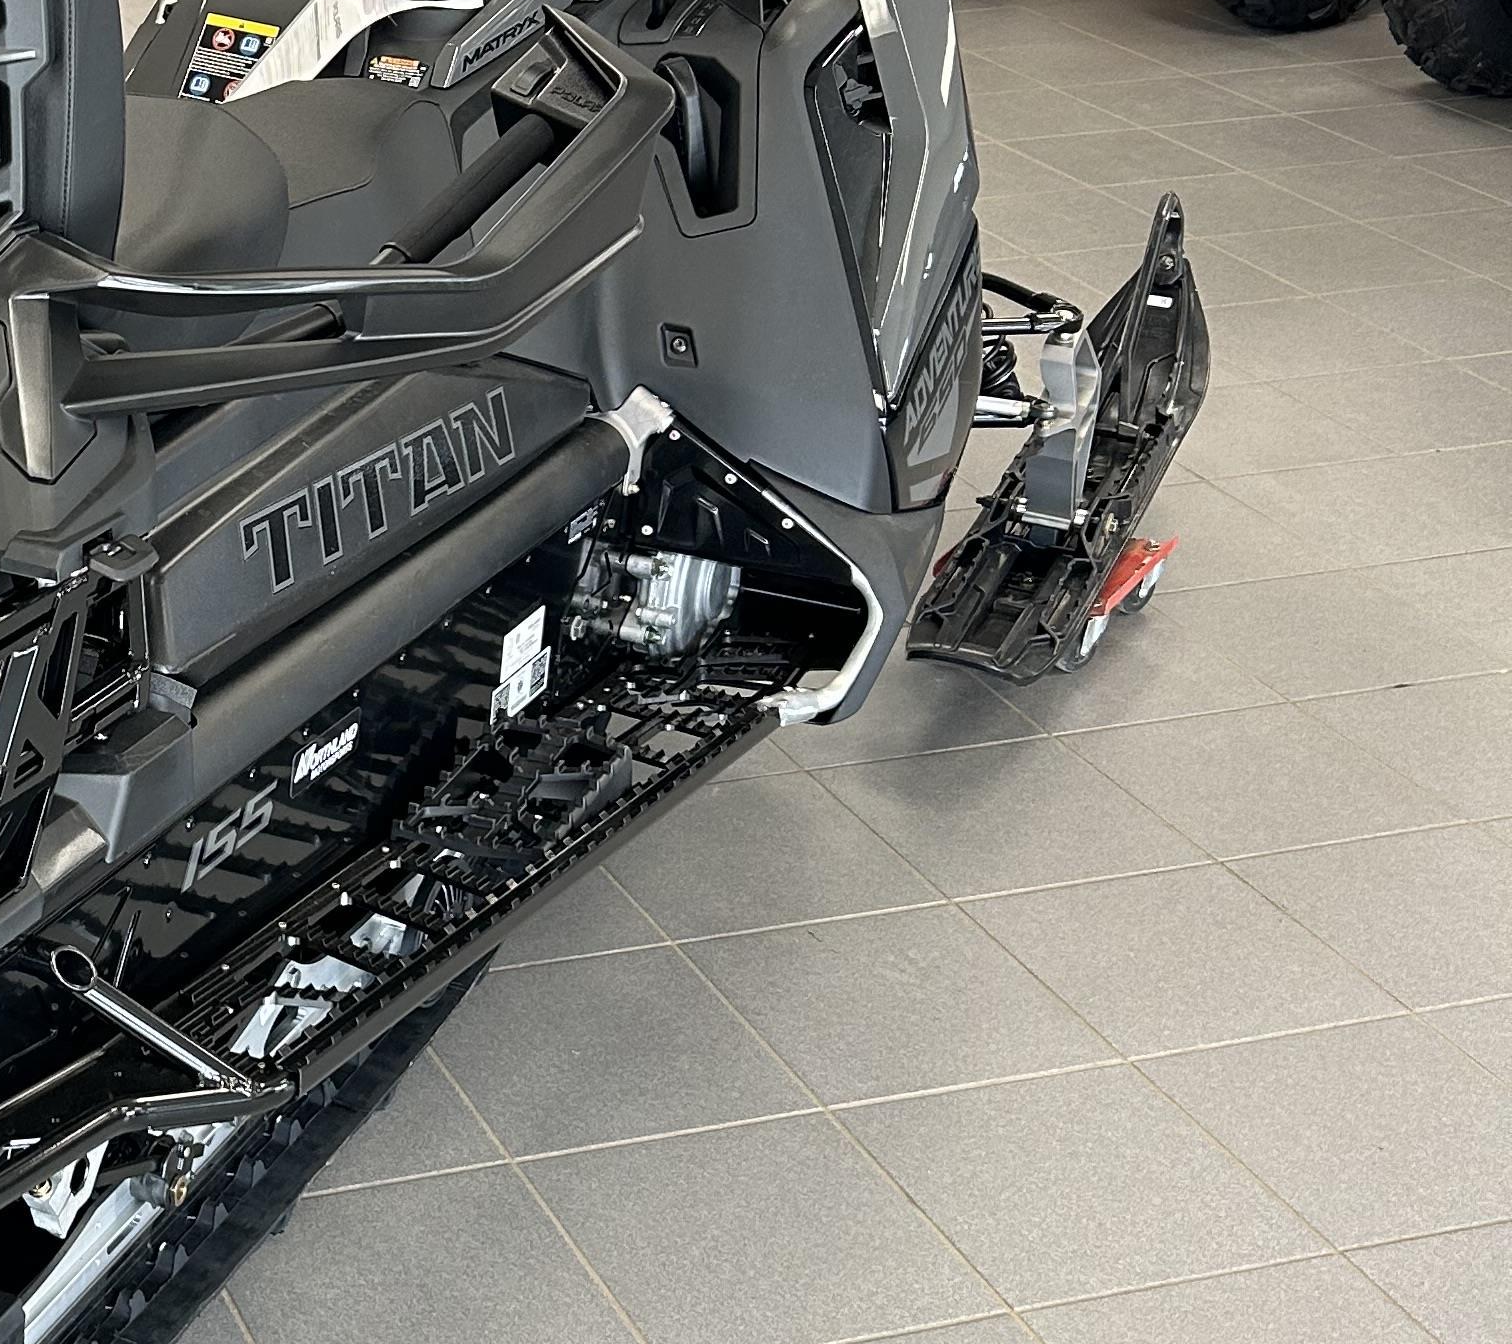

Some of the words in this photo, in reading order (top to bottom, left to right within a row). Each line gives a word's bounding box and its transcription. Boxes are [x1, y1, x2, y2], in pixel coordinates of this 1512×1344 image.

[462, 11, 541, 73] MATRYX
[239, 386, 515, 595] TITAN
[181, 779, 279, 894] 155
